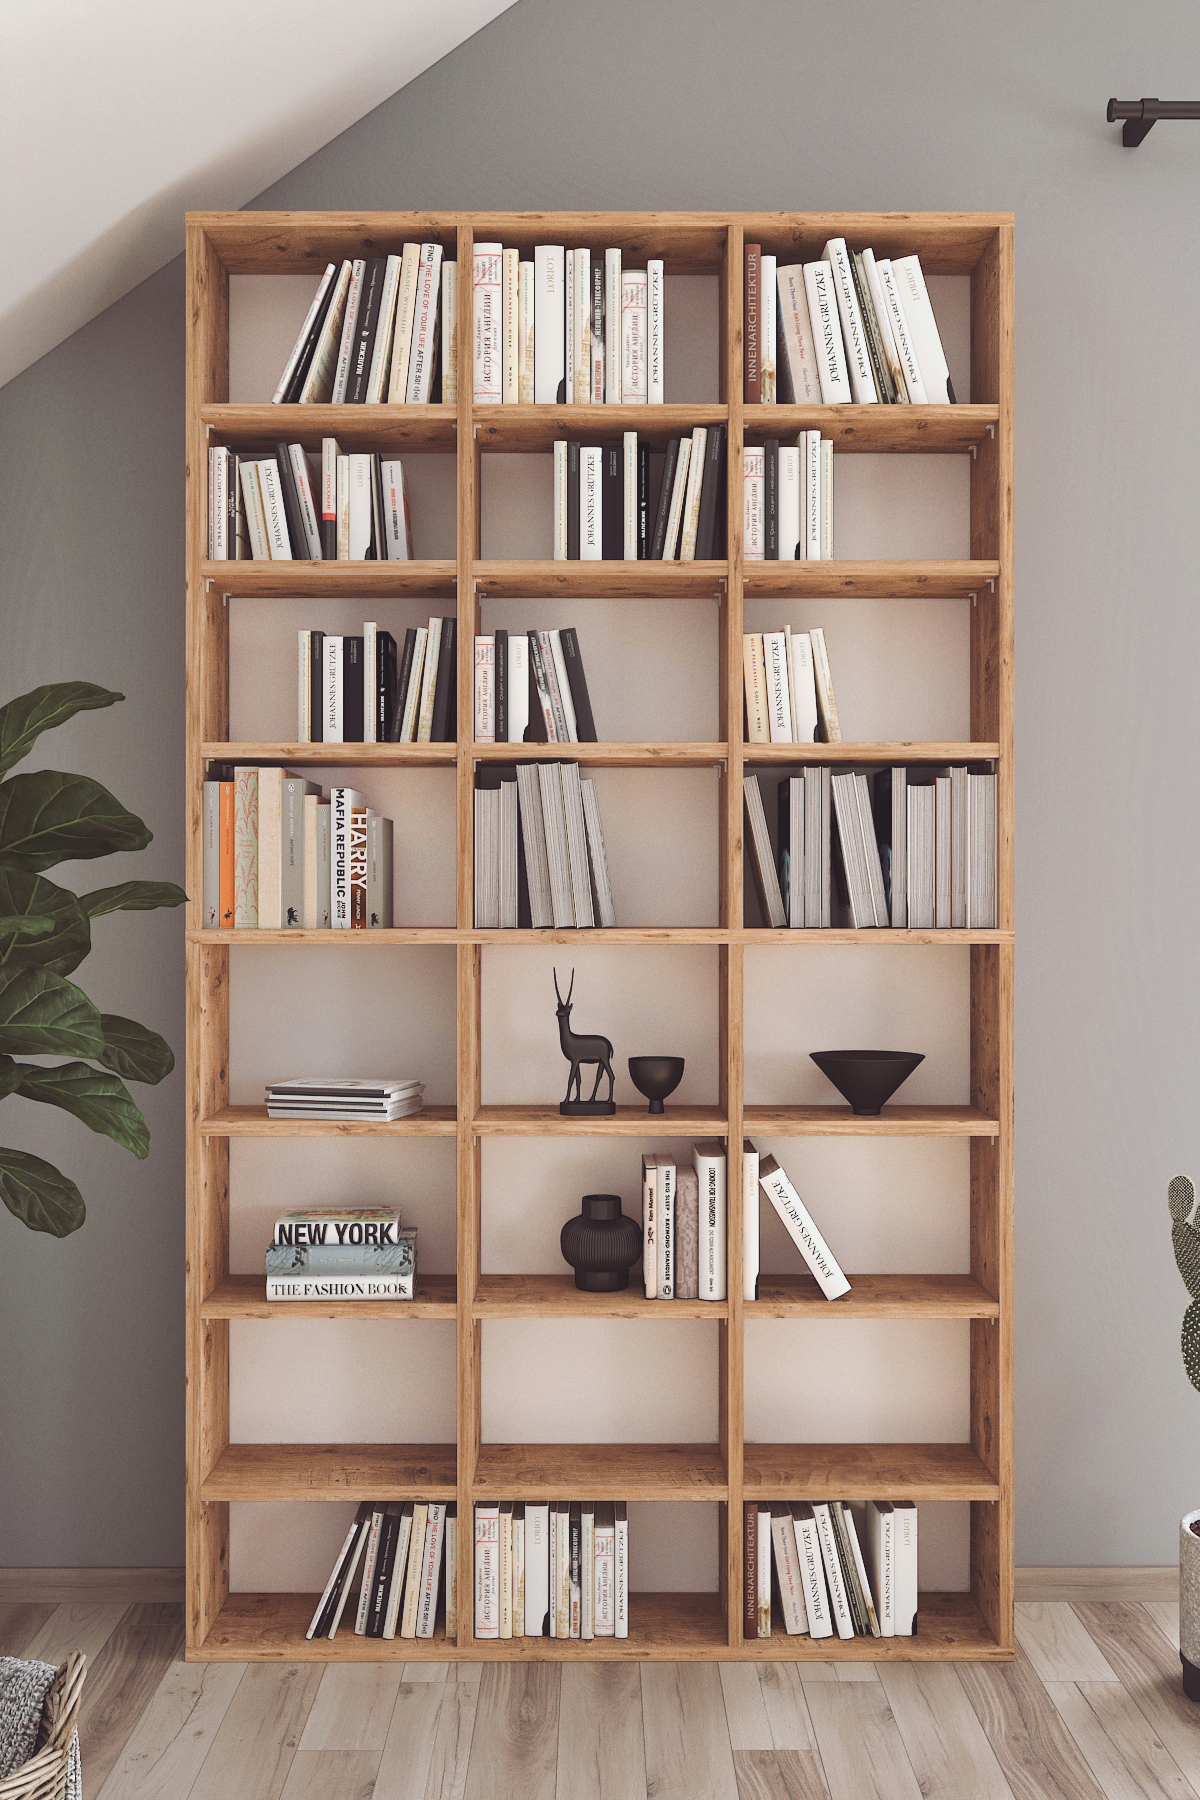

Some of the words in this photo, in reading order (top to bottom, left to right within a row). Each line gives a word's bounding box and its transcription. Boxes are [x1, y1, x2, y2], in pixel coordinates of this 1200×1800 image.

[404, 258, 413, 294] CLASSIC
[423, 279, 431, 298] LOVE
[904, 266, 920, 301] LORIOT
[400, 296, 409, 335] WORSHIP
[419, 310, 428, 332] YOUR
[422, 299, 429, 309] OF
[483, 293, 491, 332] АНГЛИИ
[748, 253, 757, 382] INNENARCHITEKTUR
[345, 321, 353, 341] YOUR
[417, 332, 425, 349] LIFE
[631, 315, 639, 346] АНГЛИИ
[849, 311, 868, 379] JOHANNES
[339, 357, 347, 379] AFTER
[356, 341, 367, 375] МАЛЕЖИК
[414, 350, 424, 374] AFTER
[483, 337, 491, 382] ИСТОРИЯ
[631, 349, 639, 387] ИСТОРИЯ
[823, 324, 840, 382] JOHANNES
[897, 323, 918, 384] JOHANNES
[270, 506, 284, 549] JOHANNES
[587, 498, 595, 546] JOHANNES
[775, 682, 785, 728] JOHANNES
[335, 789, 345, 830] MAFIA
[336, 834, 345, 898] REPUBLIC
[351, 814, 366, 889] HARRY
[708, 1167, 716, 1187] LOOKING
[708, 1187, 716, 1196] FOR
[708, 1196, 716, 1227] TRANSMISSION
[772, 1180, 804, 1226] GRÜTZKE
[279, 1224, 328, 1245] NEW
[335, 1223, 395, 1245] YORK
[799, 1225, 834, 1279] JOHANNES
[271, 1284, 300, 1296] THE
[304, 1283, 365, 1295] FASHION
[368, 1283, 408, 1295] BOOK
[427, 1560, 435, 1577] YOUR
[429, 1551, 435, 1559] OF
[747, 1512, 755, 1619] INNENARCHITEKTUR
[809, 1571, 824, 1620] JOHANNES
[830, 1563, 846, 1618] JOHANNES
